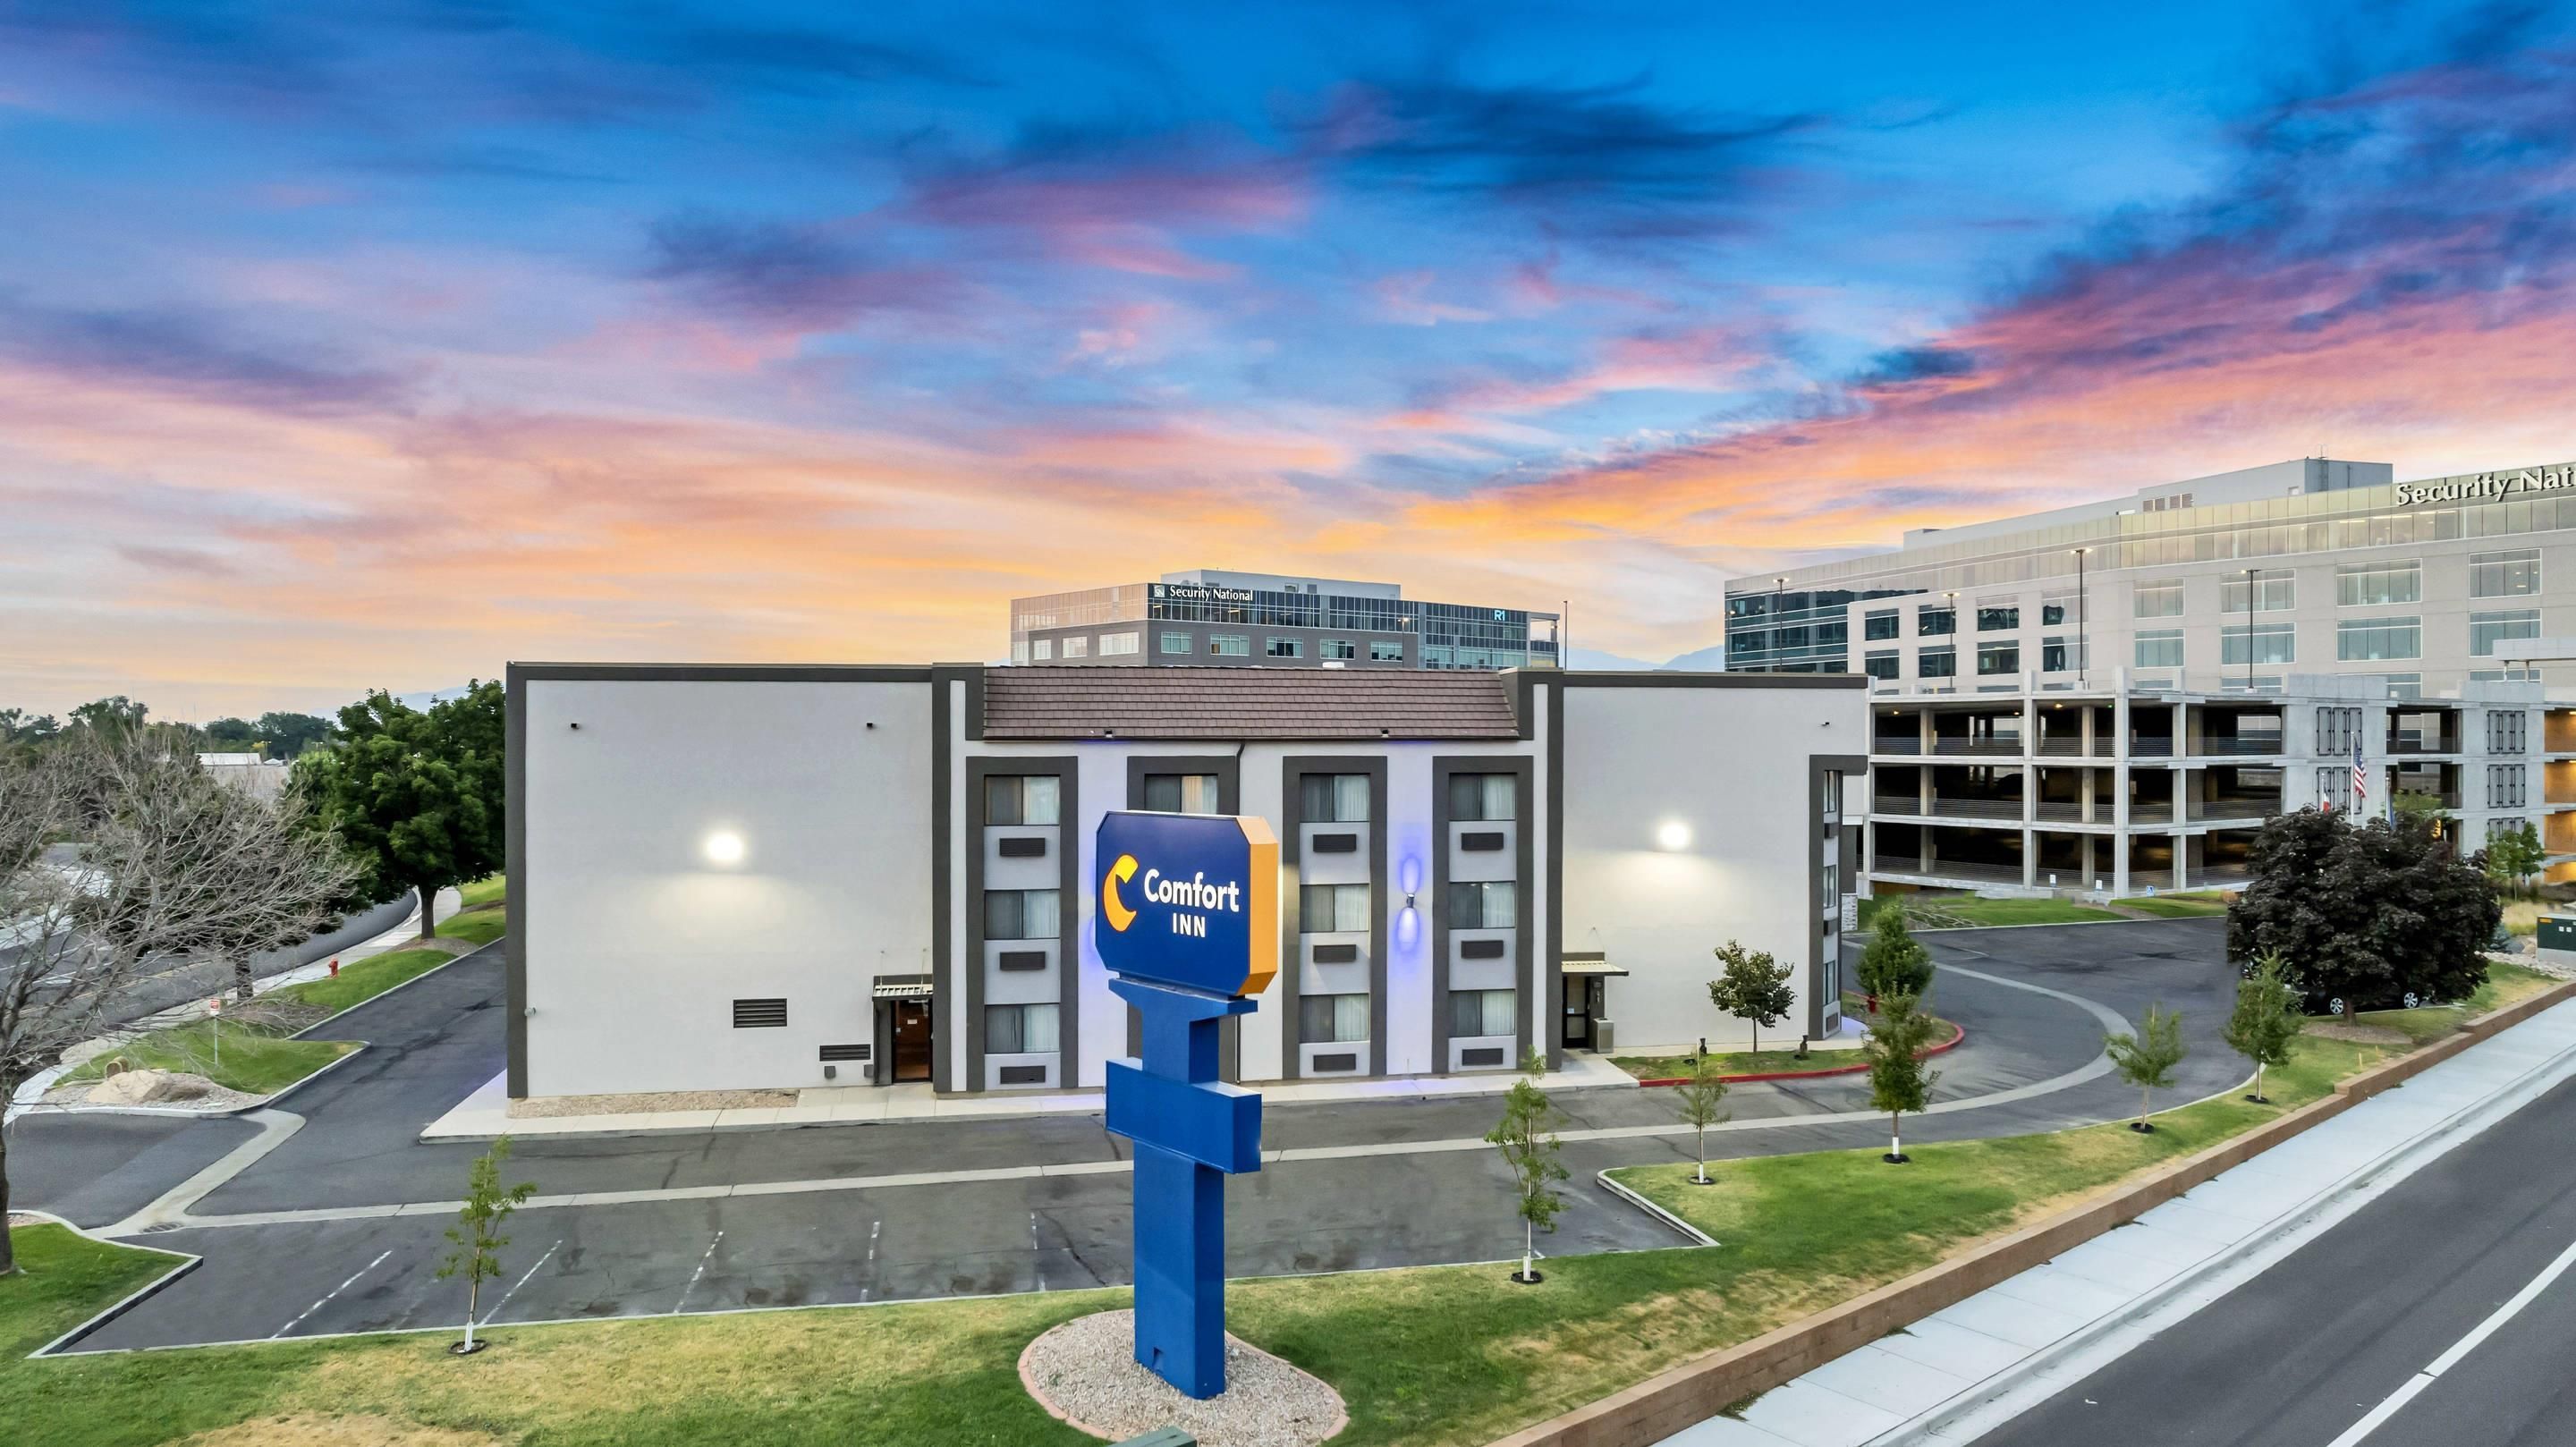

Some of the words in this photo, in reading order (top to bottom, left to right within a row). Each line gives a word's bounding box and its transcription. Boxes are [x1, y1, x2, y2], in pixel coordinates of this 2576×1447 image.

[2396, 474, 2509, 506] Security
[1170, 586, 1211, 601] Security
[1213, 588, 1253, 601] National
[1494, 610, 1505, 622] R1
[1144, 868, 1240, 912] Comfort
[1173, 912, 1206, 938] INN
